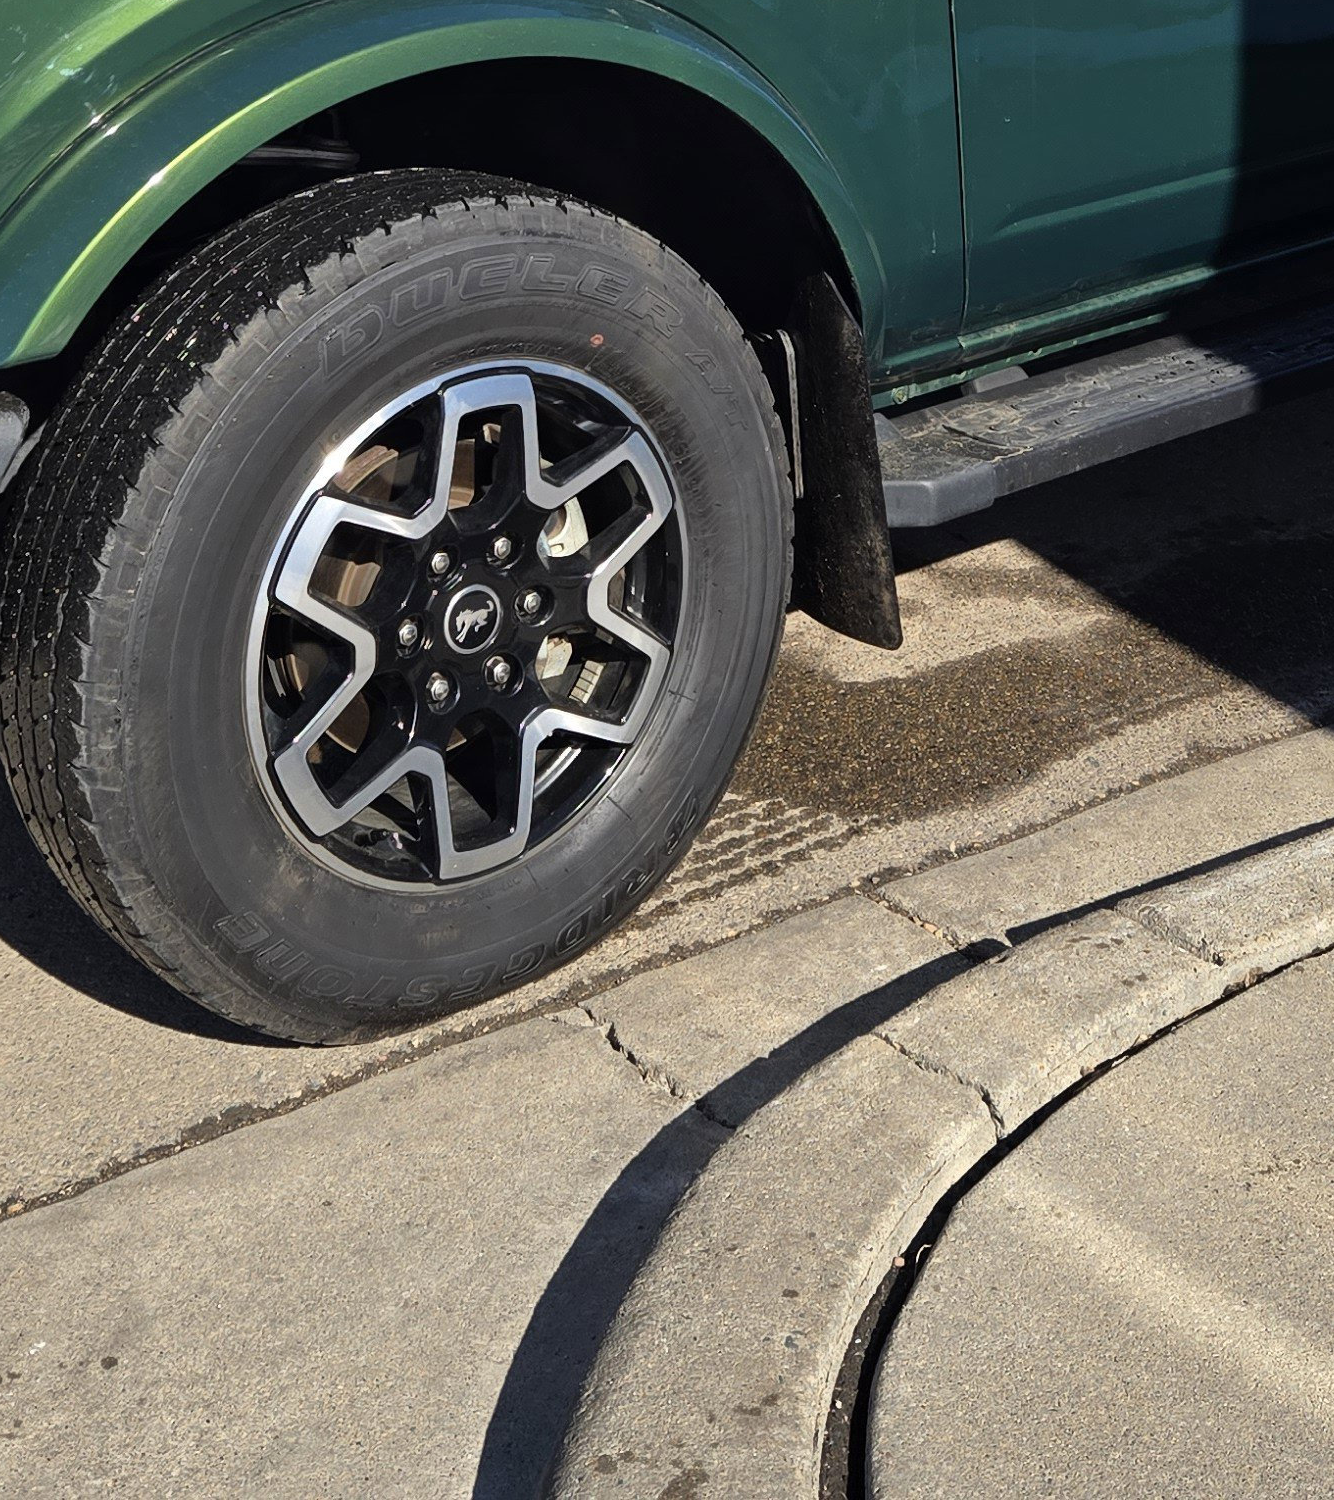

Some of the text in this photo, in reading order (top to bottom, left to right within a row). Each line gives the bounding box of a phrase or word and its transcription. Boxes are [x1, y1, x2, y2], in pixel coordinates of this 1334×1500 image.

[317, 251, 750, 433] DUELER A/T
[211, 783, 700, 1010] BRIDGESTONE
